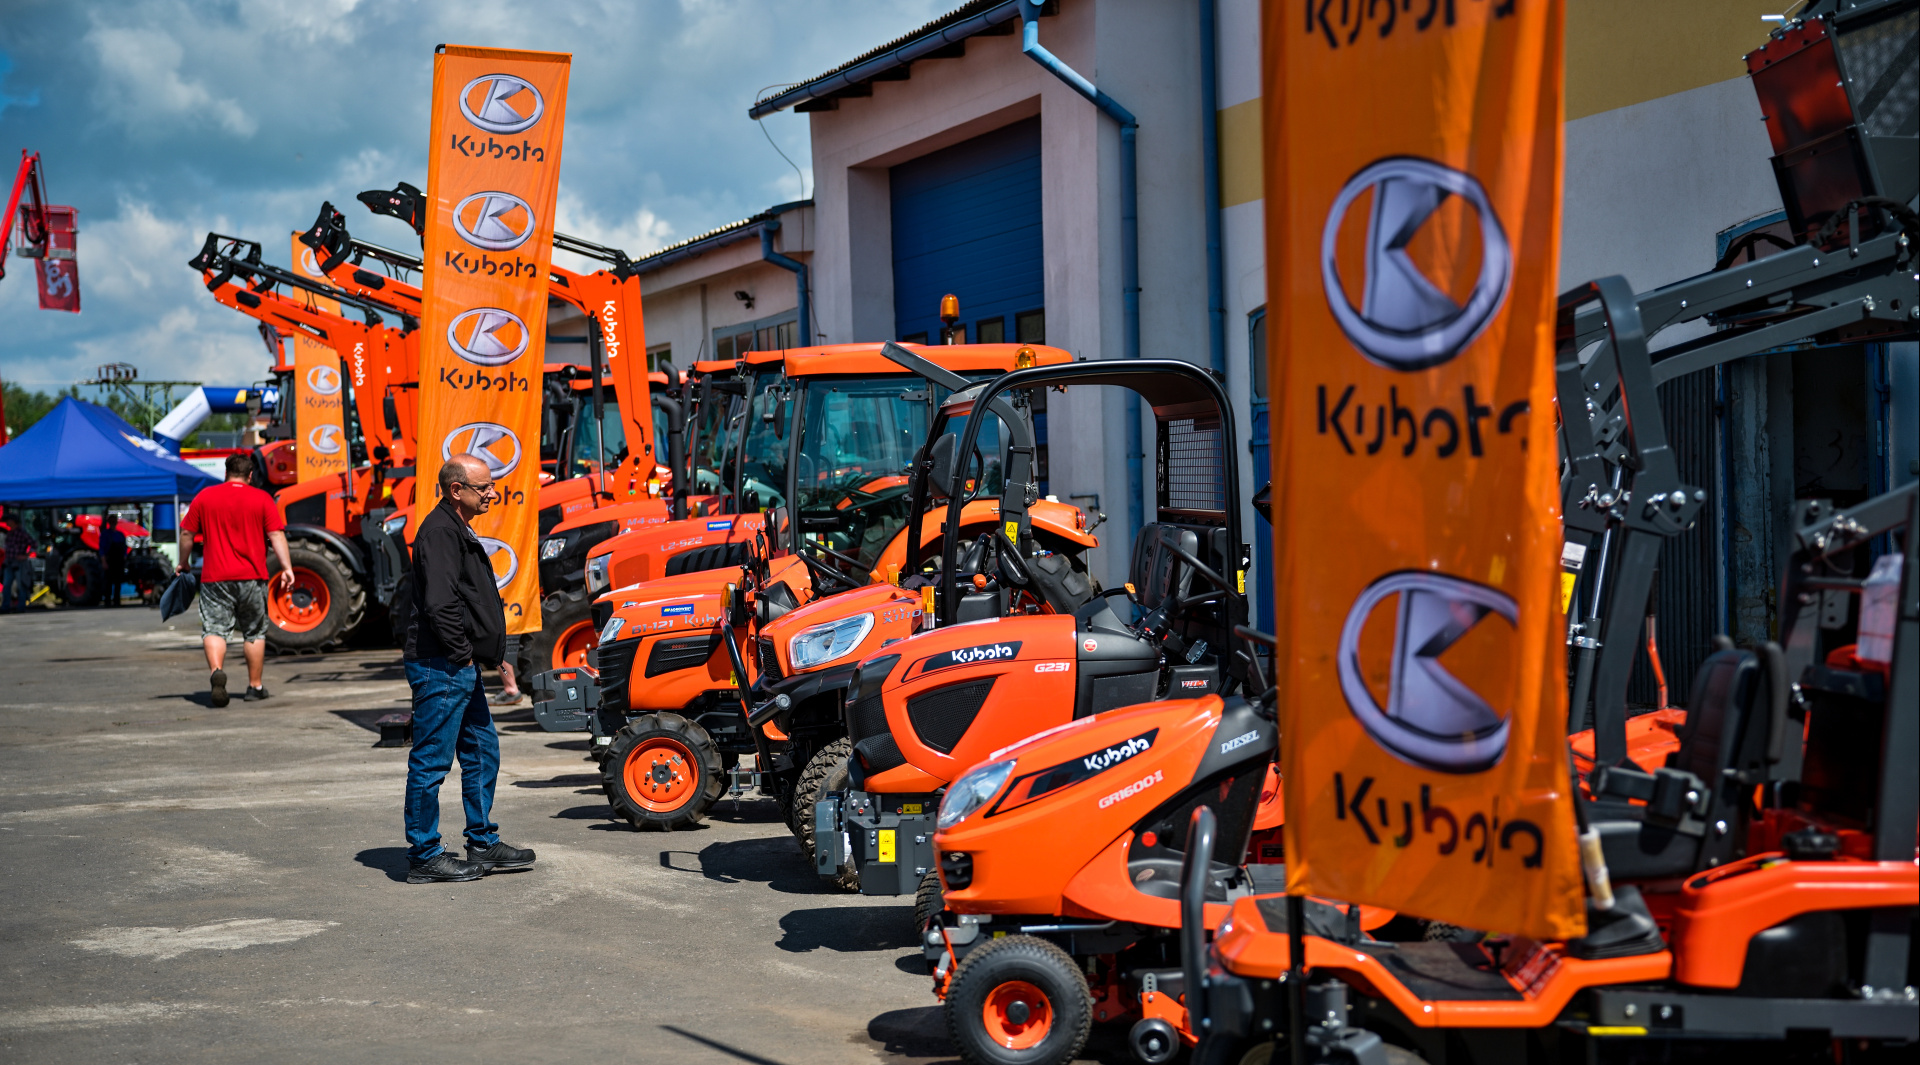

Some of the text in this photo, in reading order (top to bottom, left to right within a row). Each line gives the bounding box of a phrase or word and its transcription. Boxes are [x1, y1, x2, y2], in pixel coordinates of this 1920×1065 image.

[1305, 0, 1515, 49] Kubo
[451, 134, 544, 162] Kubota
[445, 251, 537, 278] Kubota
[602, 300, 620, 358] Kubota
[353, 342, 366, 387] Kubota
[441, 367, 528, 392] Kubota
[661, 536, 703, 552] L2-522
[632, 620, 674, 634] B1-121
[883, 609, 923, 624] X1110
[951, 643, 1013, 663] Kubota
[1034, 662, 1070, 673] G231
[1083, 737, 1150, 770] Kubota
[1220, 730, 1260, 754] DIESEL
